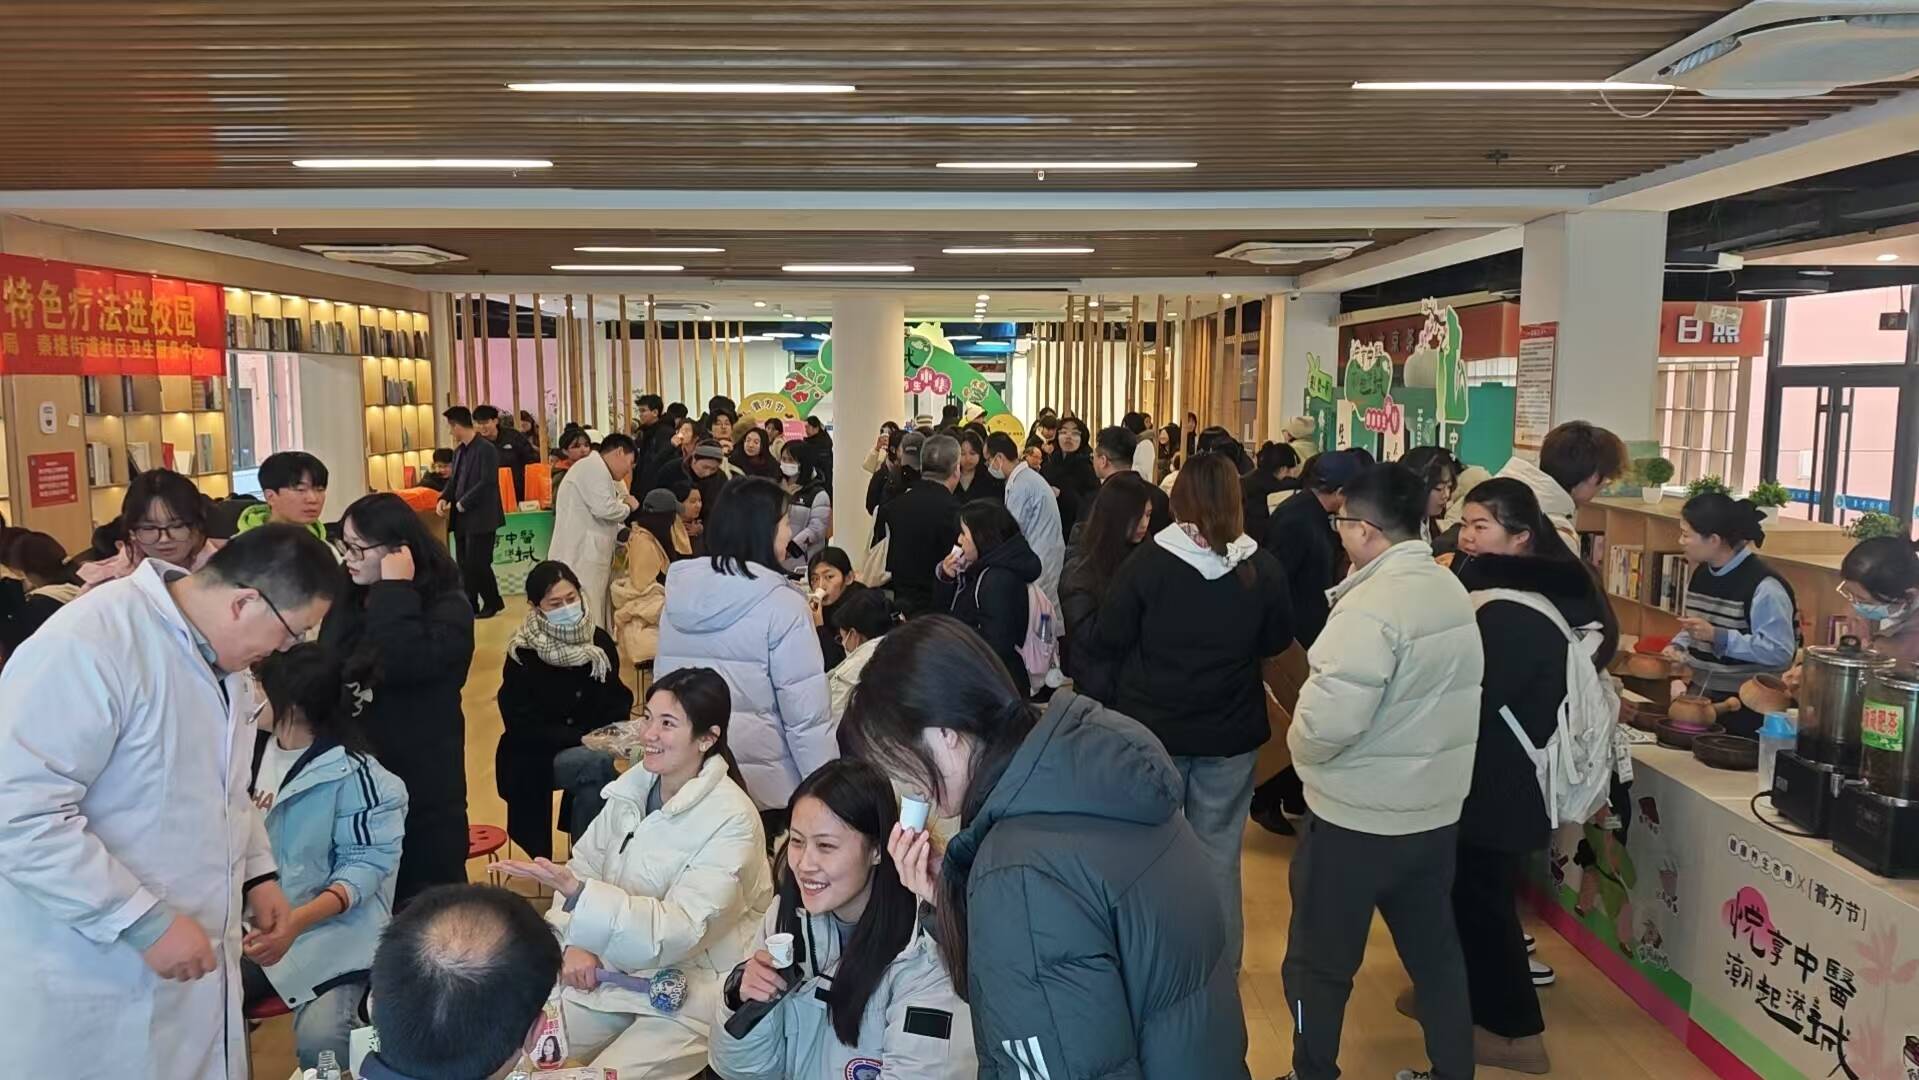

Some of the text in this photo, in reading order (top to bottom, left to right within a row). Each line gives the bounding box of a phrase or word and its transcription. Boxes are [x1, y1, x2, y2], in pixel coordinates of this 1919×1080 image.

[3, 275, 196, 337] 特色疗法进校园
[1678, 315, 1740, 344] 日照
